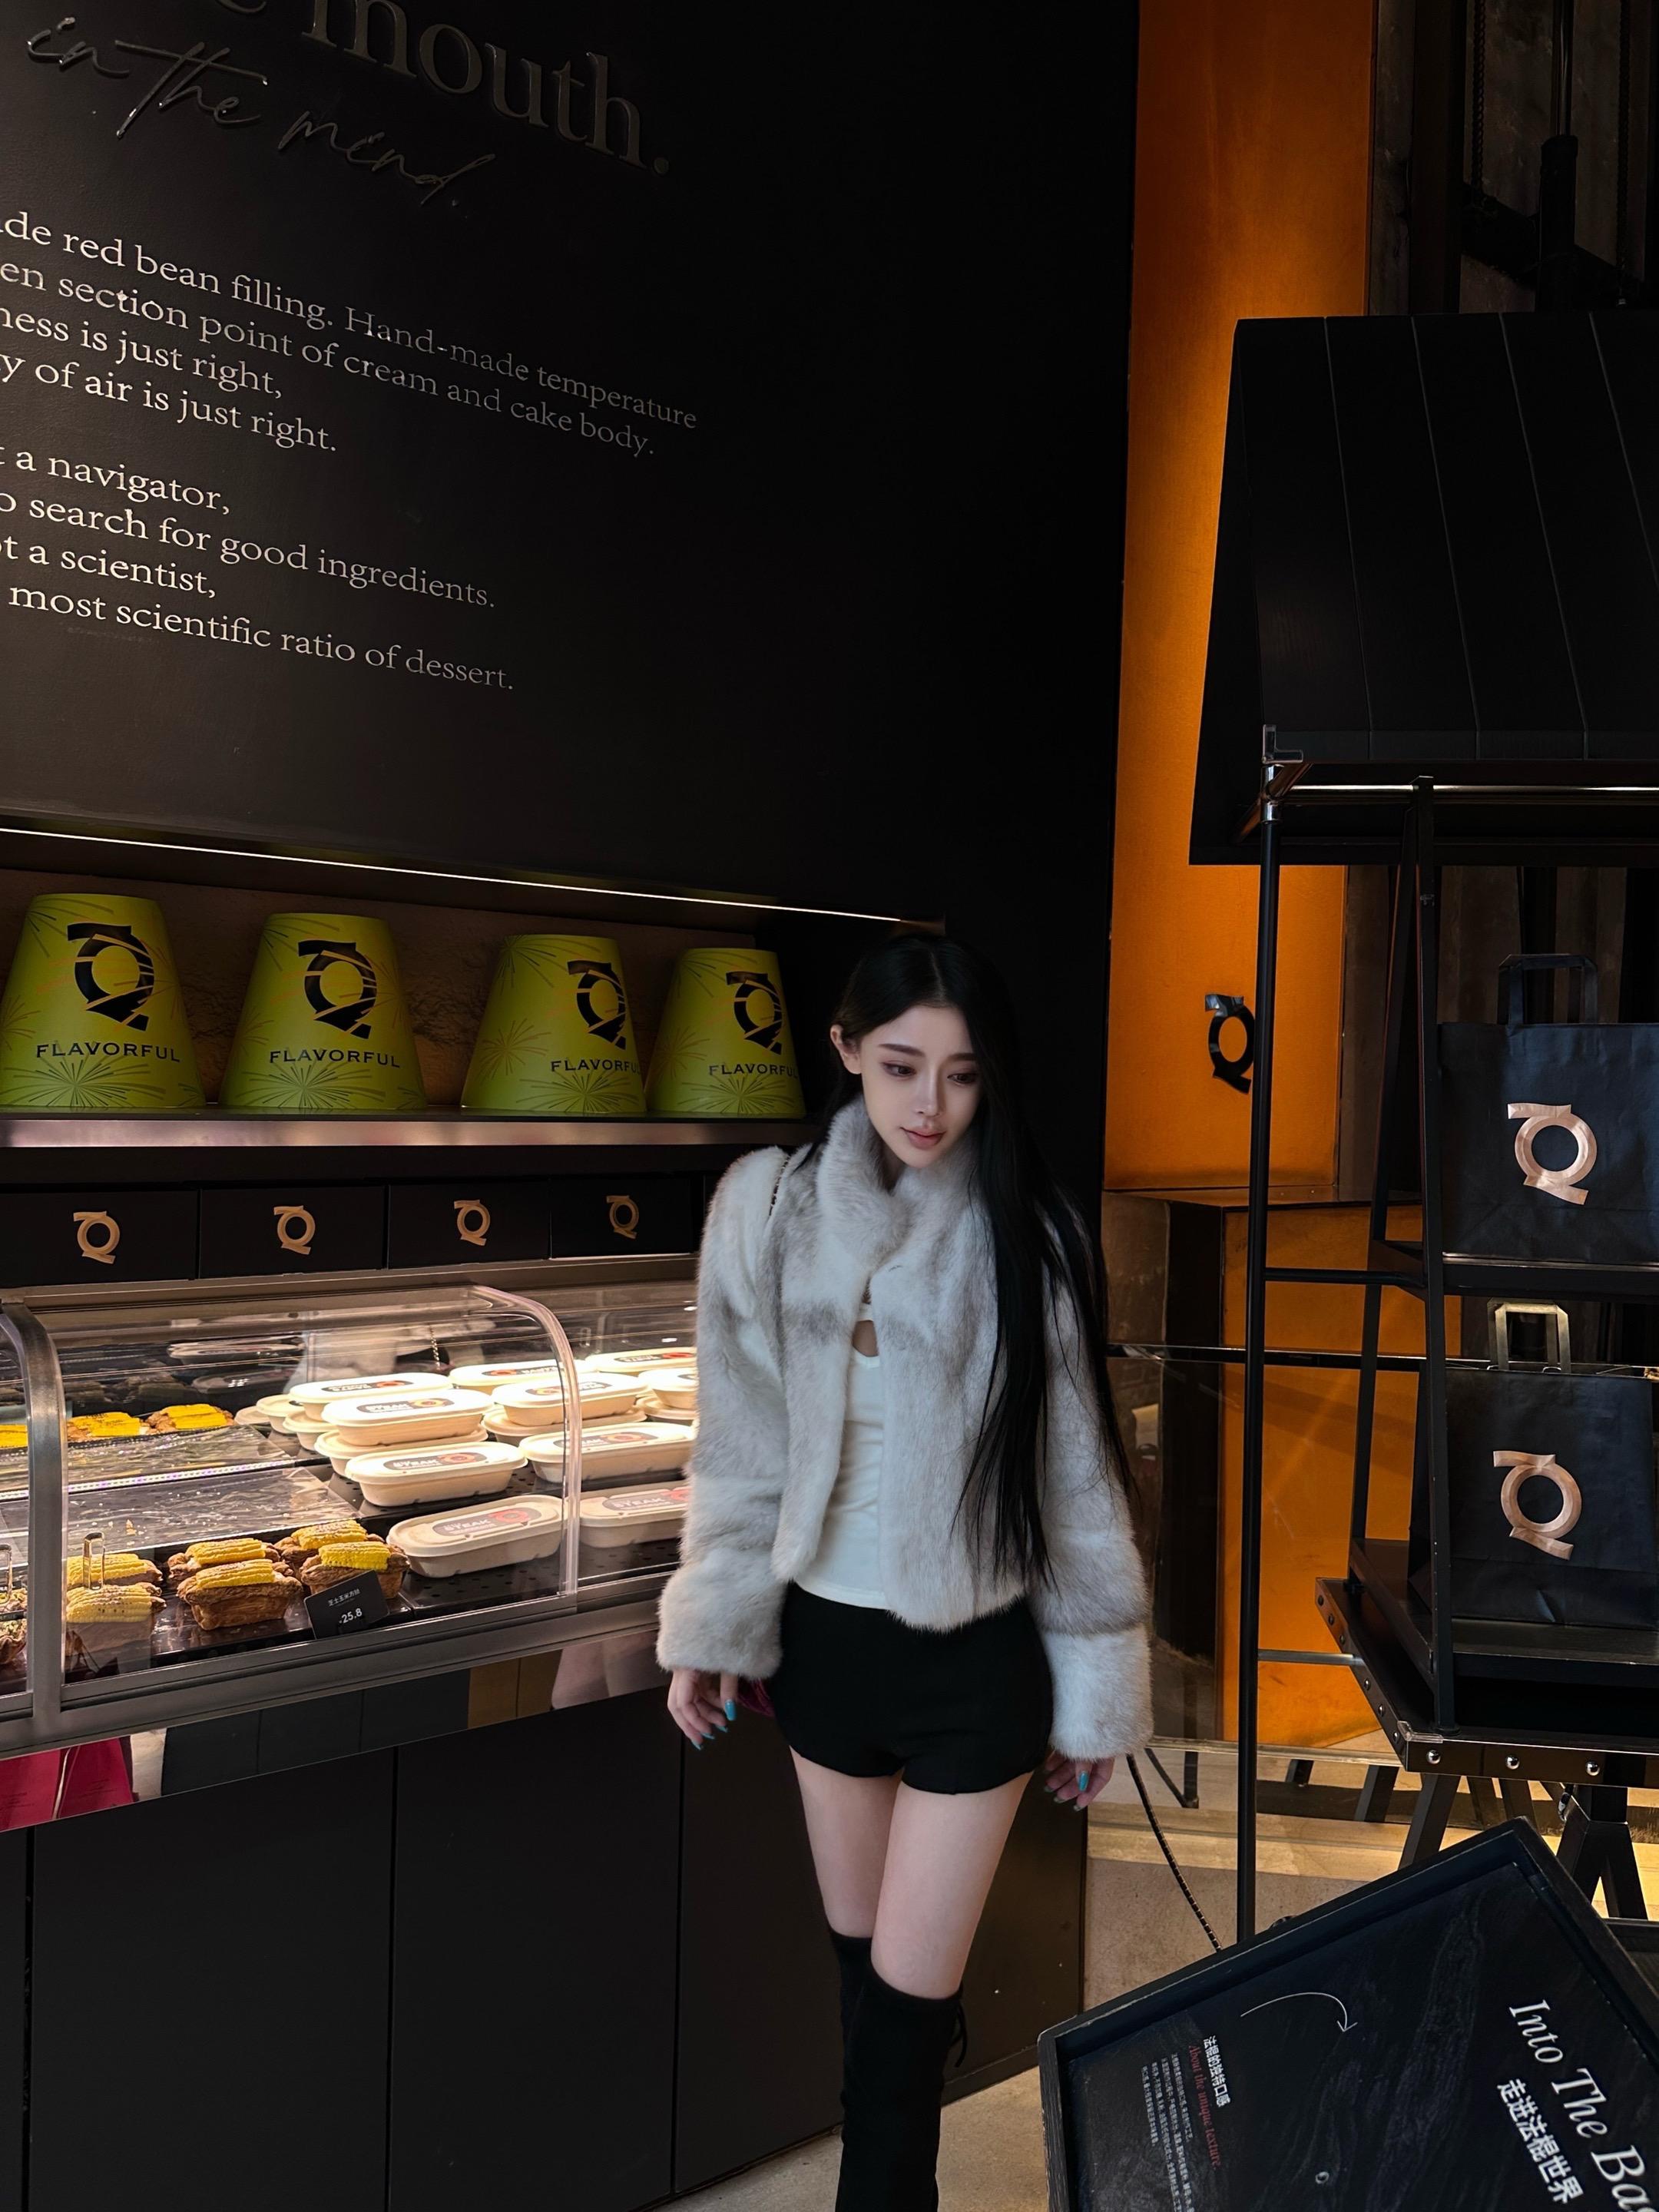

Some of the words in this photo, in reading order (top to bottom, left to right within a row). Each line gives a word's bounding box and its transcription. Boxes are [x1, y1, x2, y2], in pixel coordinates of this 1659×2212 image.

[27, 16, 131, 76] in
[114, 41, 268, 139] the
[301, 0, 671, 177] mouth.
[0, 211, 51, 246] de
[62, 233, 125, 267] red
[134, 244, 222, 296] bean
[231, 273, 333, 329] filling.
[344, 306, 529, 381] Hand-made
[537, 366, 697, 429] temperature
[58, 277, 190, 329] section
[199, 315, 293, 358] point
[300, 342, 339, 368] of
[343, 356, 439, 396] cream
[447, 383, 502, 412] and
[509, 401, 573, 432] cake
[579, 412, 654, 458] body.
[80, 321, 108, 352] is
[115, 330, 184, 372] just
[192, 353, 283, 399] right,
[35, 362, 80, 389] of
[84, 372, 134, 402] air
[143, 381, 170, 412] is
[176, 390, 242, 429] just
[250, 412, 337, 452] right.
[16, 450, 37, 472] a
[47, 457, 230, 515] navigator,
[0, 535, 18, 561] t
[28, 544, 50, 566] a
[61, 549, 217, 599] scientist,
[29, 498, 149, 539] search
[159, 517, 211, 551] for
[220, 538, 309, 571] good
[317, 548, 495, 609] ingredients.
[8, 587, 107, 621] most
[116, 603, 271, 647] scientific
[280, 633, 356, 662] ratio
[365, 644, 402, 670] of
[406, 648, 515, 690] dessert.
[36, 1041, 180, 1063] FLAVORFUL
[270, 1048, 400, 1068] FLAVORFUL
[443, 1518, 492, 1532] STEAK
[1189, 2045, 1203, 2073] About
[1194, 2075, 1205, 2089] the
[1203, 2035, 1231, 2108] 法棍的独特口感
[1197, 2091, 1213, 2126] unique
[1497, 2078, 1584, 2204] 走进法棍世界
[1508, 1999, 1564, 2064] Into
[1551, 2068, 1608, 2138] The
[1591, 2144, 1657, 2212] Ba
[1205, 2128, 1221, 2171] texture.
